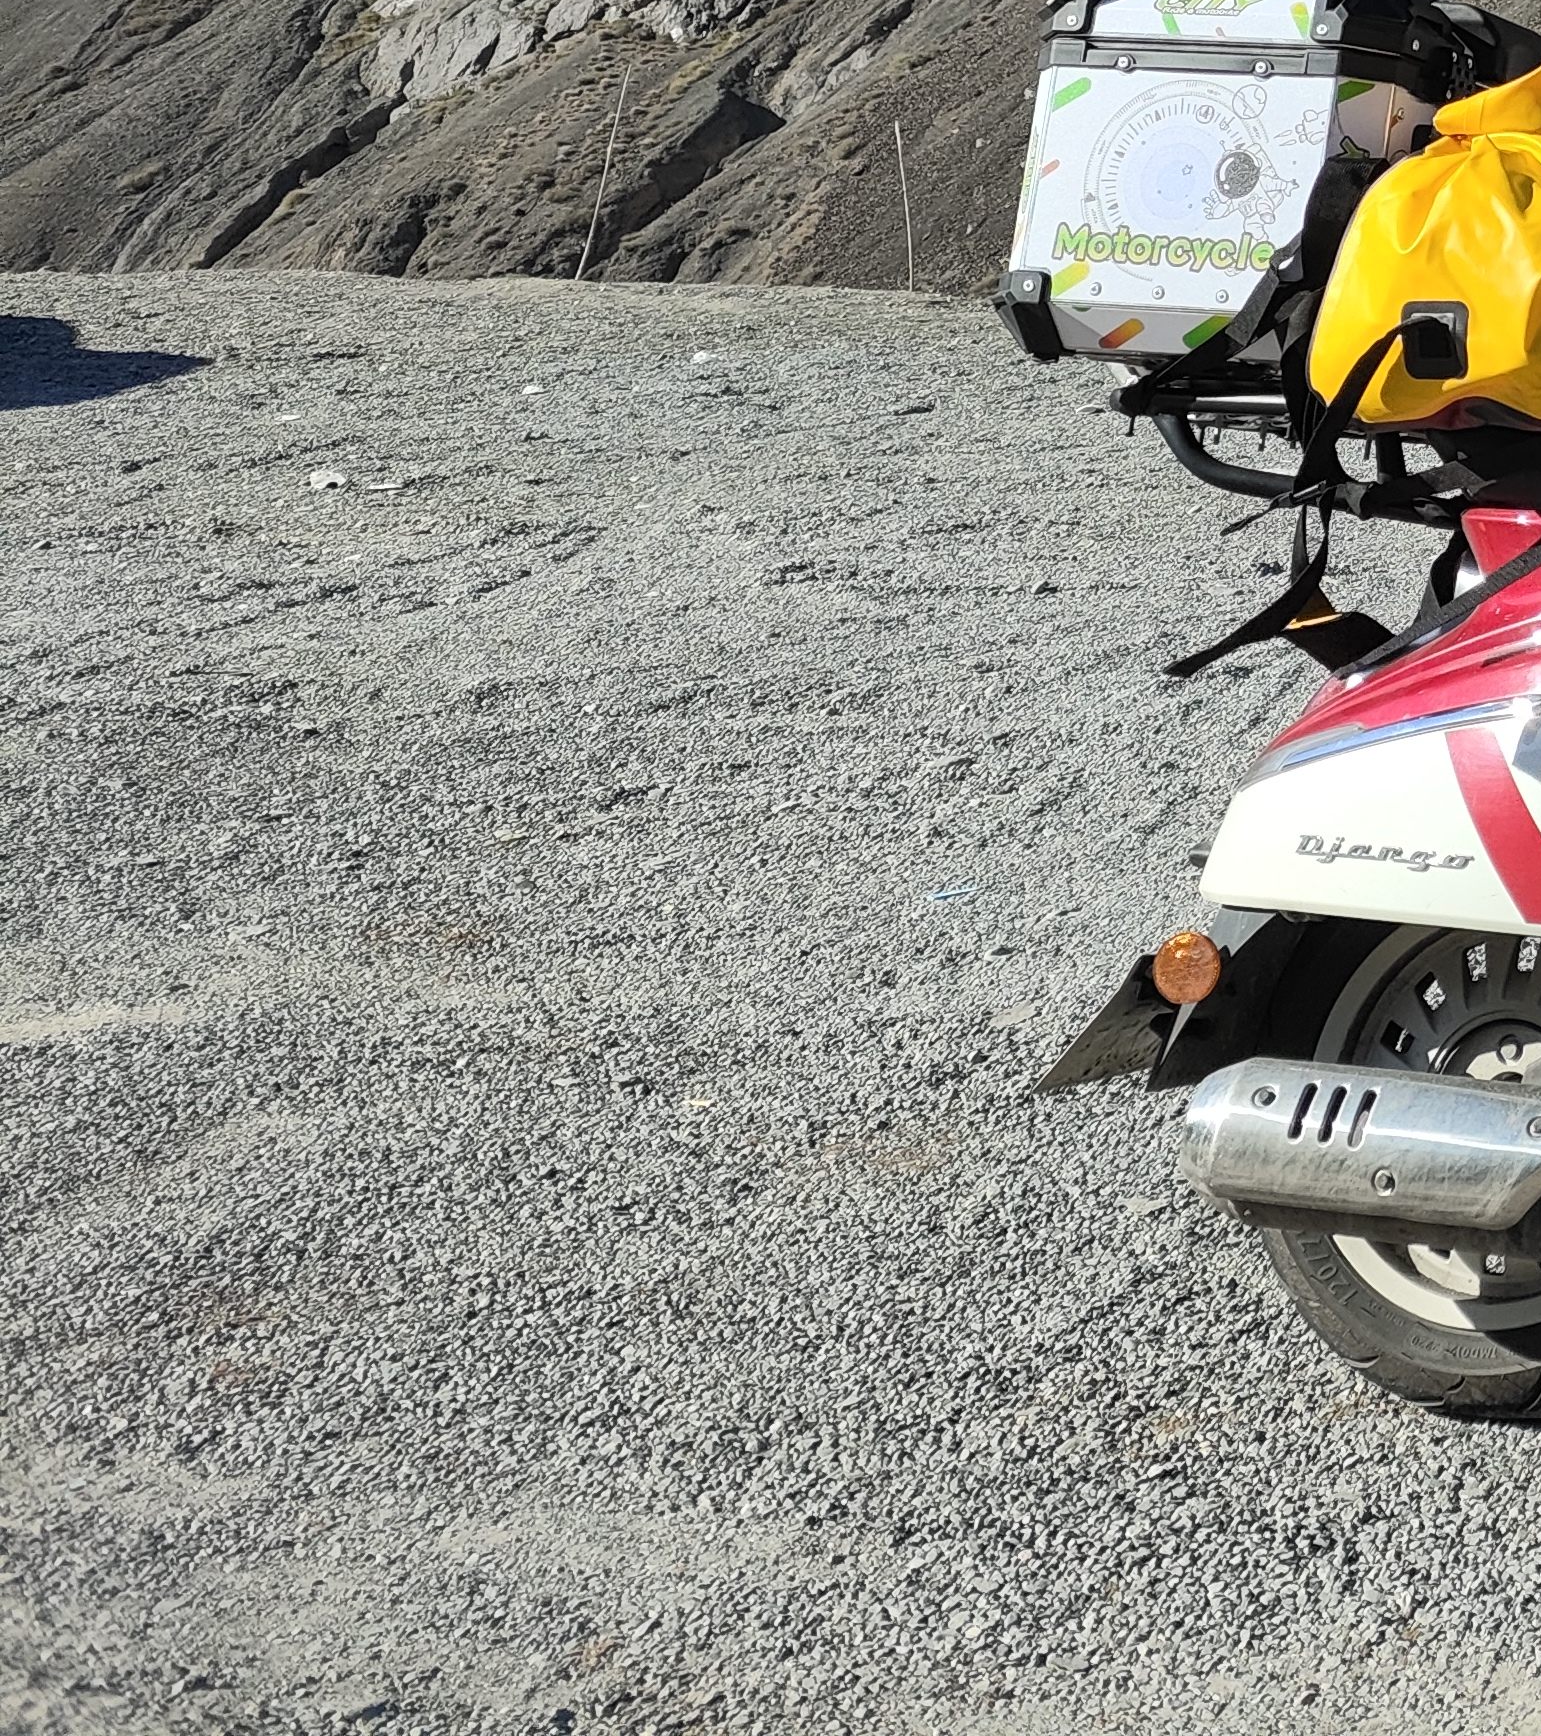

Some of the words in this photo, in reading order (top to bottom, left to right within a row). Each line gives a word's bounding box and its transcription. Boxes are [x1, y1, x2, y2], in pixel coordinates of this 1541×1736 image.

[1052, 222, 1276, 273] Motorcycle
[1295, 834, 1475, 873] Django
[1291, 1230, 1358, 1306] 120/7
